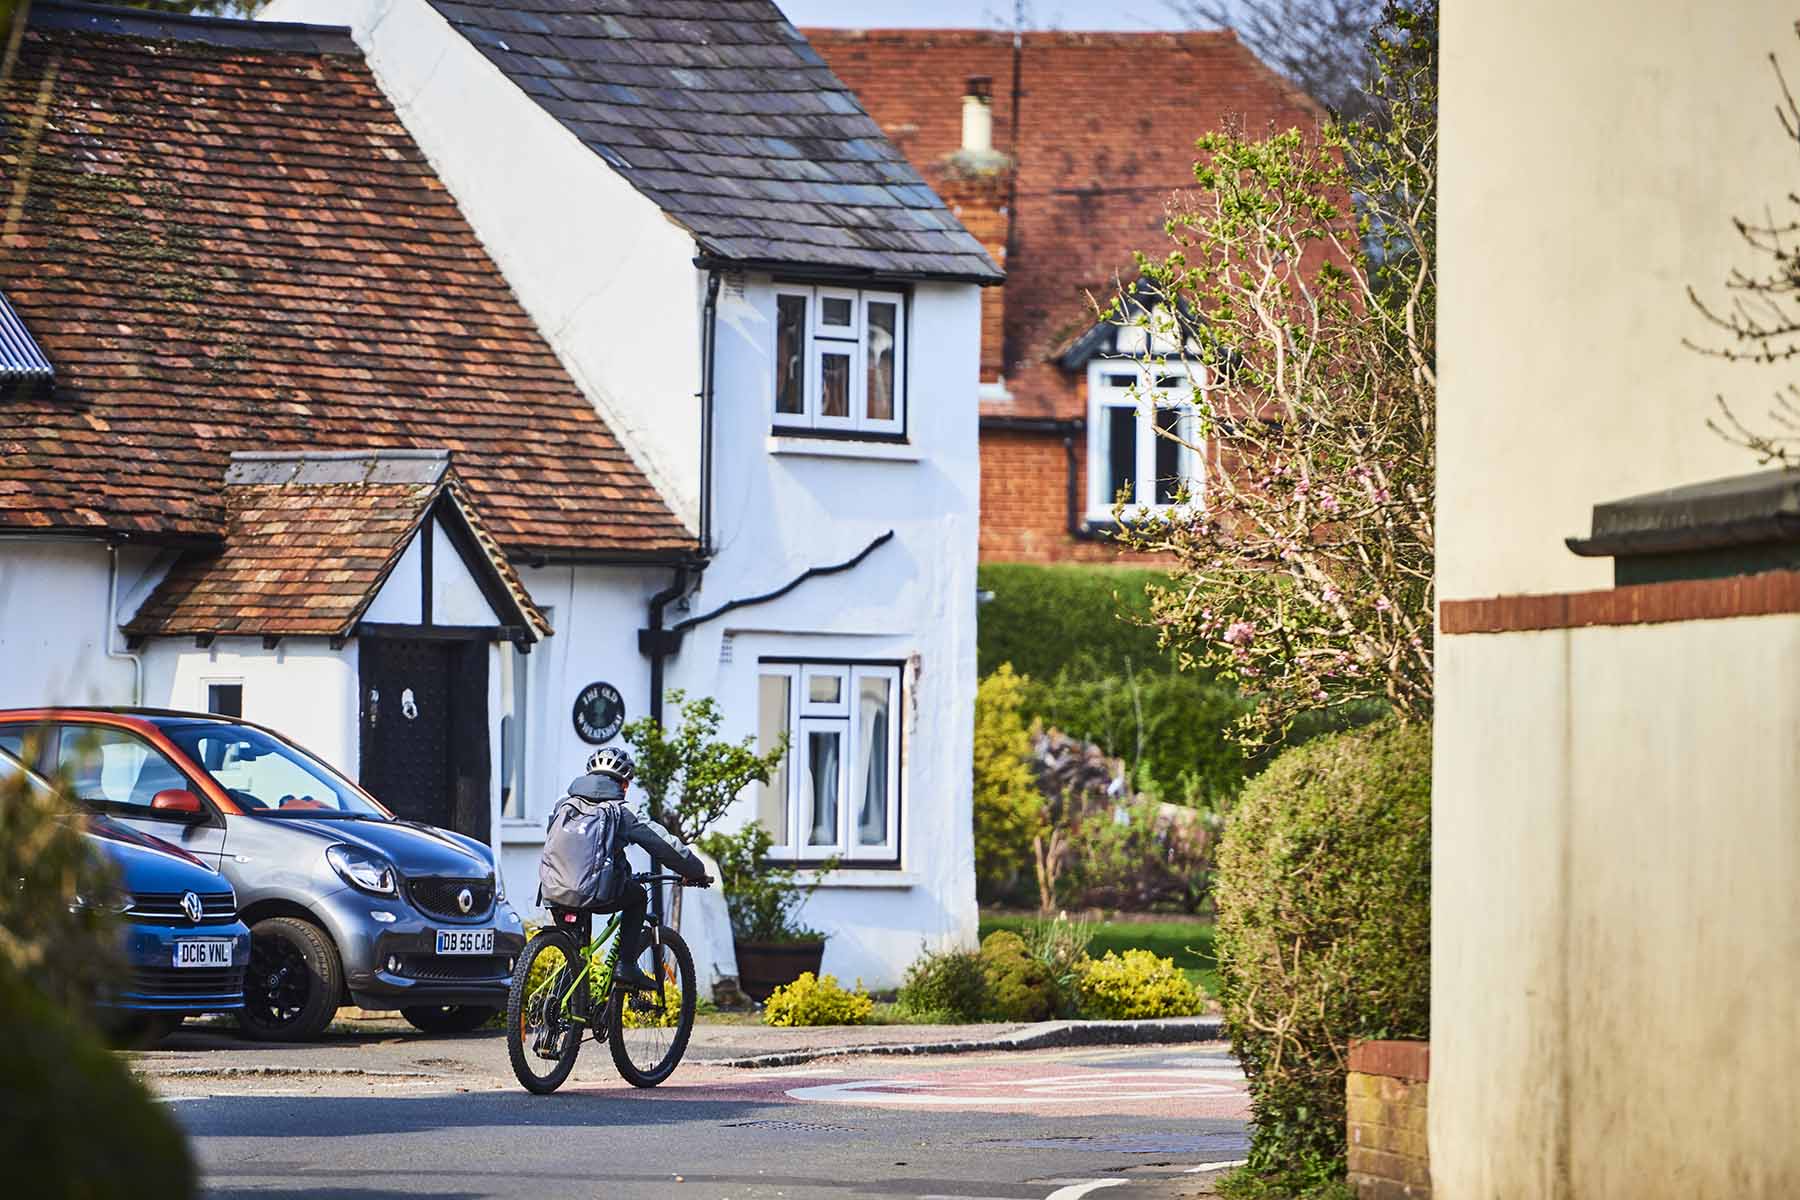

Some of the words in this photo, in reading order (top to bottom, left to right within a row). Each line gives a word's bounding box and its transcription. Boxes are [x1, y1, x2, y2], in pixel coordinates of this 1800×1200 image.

[582, 688, 598, 705] THE
[601, 687, 618, 703] OLD
[443, 933, 457, 950] DB
[460, 933, 473, 950] 56
[474, 933, 493, 950] CAB
[182, 944, 206, 962] DC16
